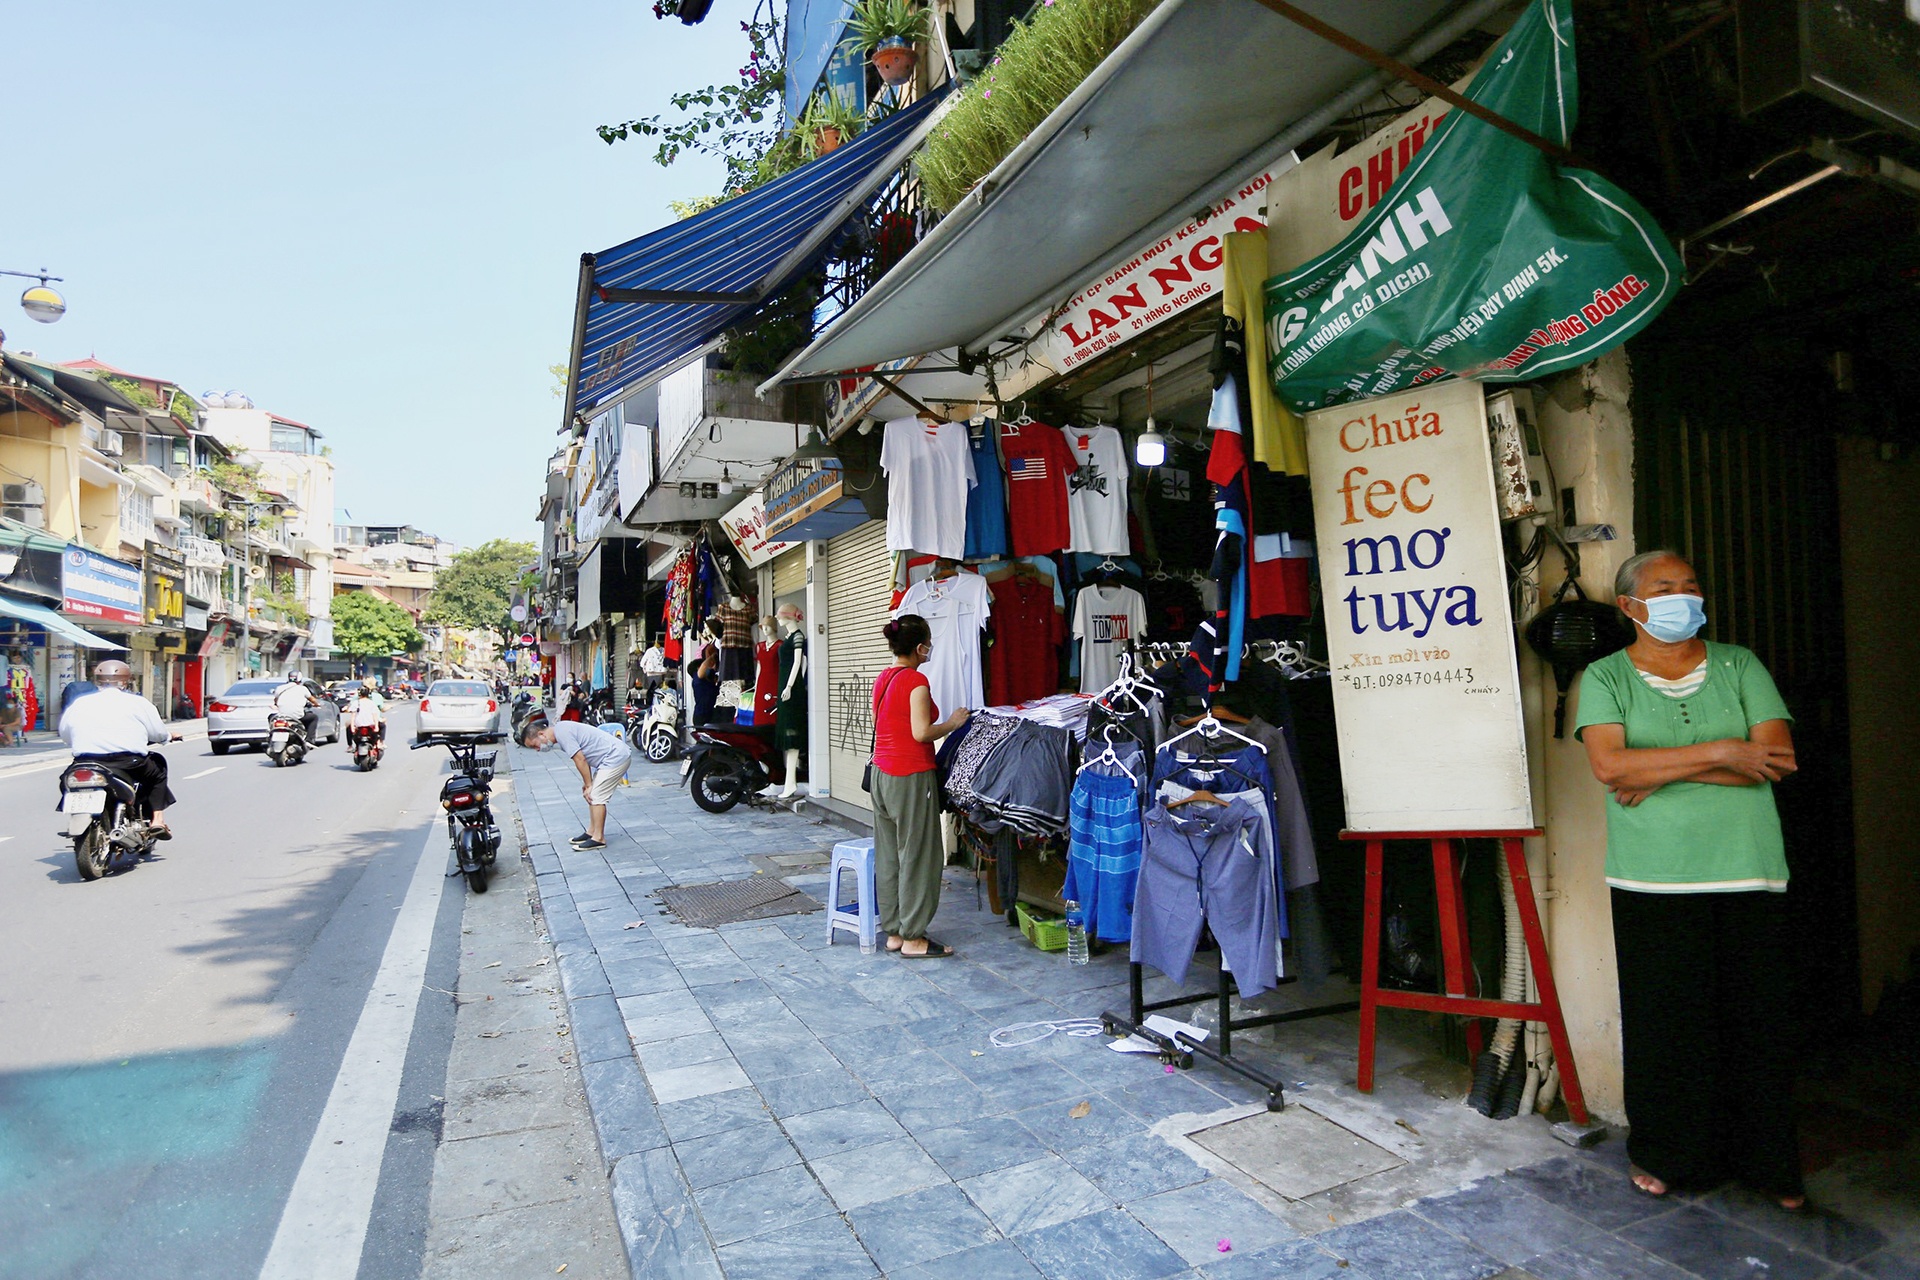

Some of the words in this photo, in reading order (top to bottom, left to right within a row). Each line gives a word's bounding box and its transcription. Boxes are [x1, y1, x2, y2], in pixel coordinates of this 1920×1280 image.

[1339, 112, 1449, 221] CHỮ
[1071, 295, 1084, 307] TY
[1086, 283, 1102, 298] CP
[1104, 257, 1141, 286] BÁNH
[1238, 172, 1273, 201] NỘI
[1131, 318, 1144, 331] 29
[1172, 282, 1212, 309] NGANG
[1478, 291, 1505, 322] QUY
[1502, 264, 1540, 302] ĐỊNH
[1535, 246, 1570, 275] 5K.
[1524, 328, 1555, 349] VÀ
[1580, 273, 1651, 327] ĐỒNG.
[1060, 282, 1148, 348] LAN
[1285, 349, 1313, 377] TOÀN
[1306, 311, 1352, 353] KHÔNG
[1351, 292, 1375, 319] CÓ
[1375, 261, 1431, 304] DỊCH)
[1074, 346, 1094, 362] 0904
[1105, 331, 1122, 344] 464
[1338, 403, 1444, 453] Chữa
[1336, 466, 1435, 526] fec
[1342, 527, 1452, 577] mơ
[1343, 585, 1483, 639] tuya
[1349, 652, 1383, 668] Xin
